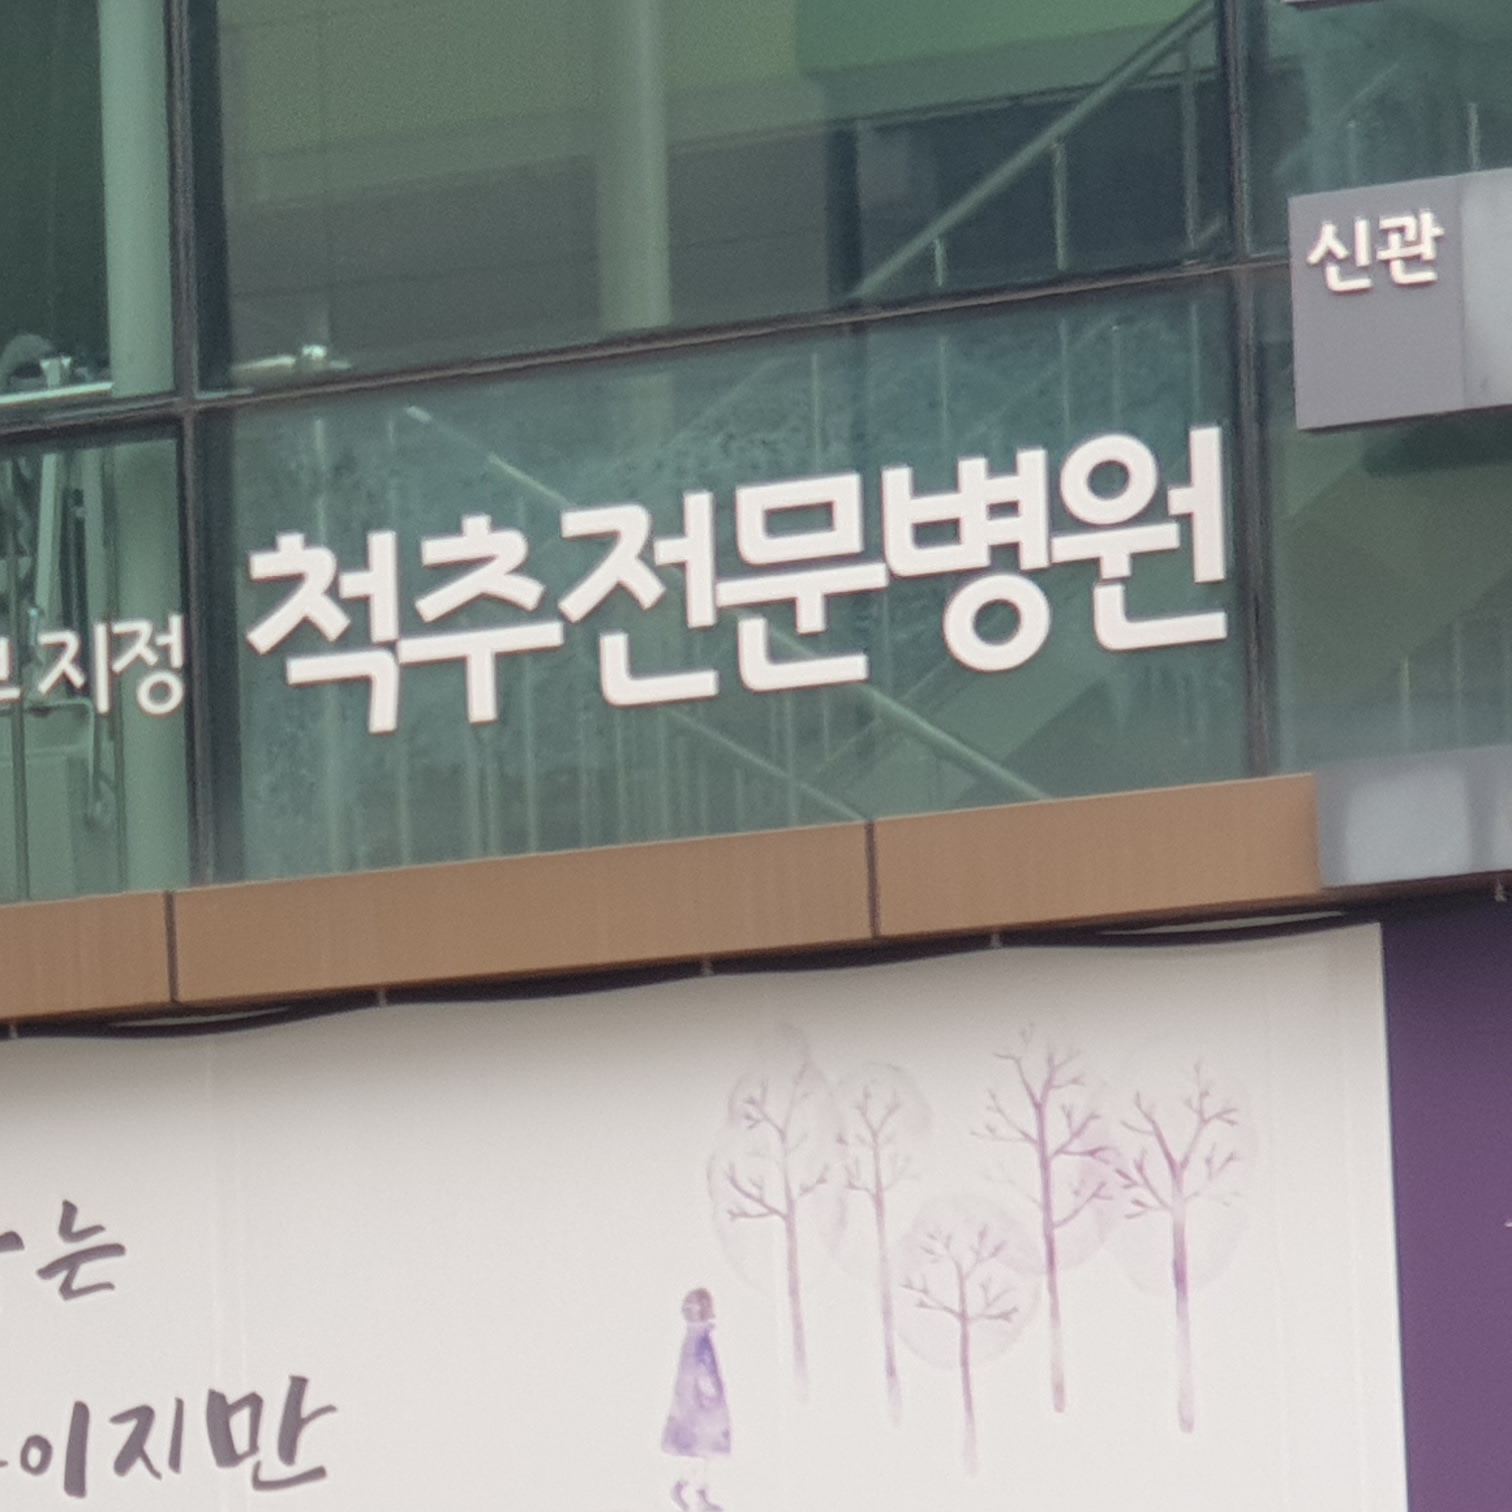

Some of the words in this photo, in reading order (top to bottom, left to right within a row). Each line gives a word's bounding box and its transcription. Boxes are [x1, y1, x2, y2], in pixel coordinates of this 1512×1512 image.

[1306, 208, 1445, 292] 신관
[246, 425, 1228, 735] 척추전문병원
[37, 614, 184, 715] 지정
